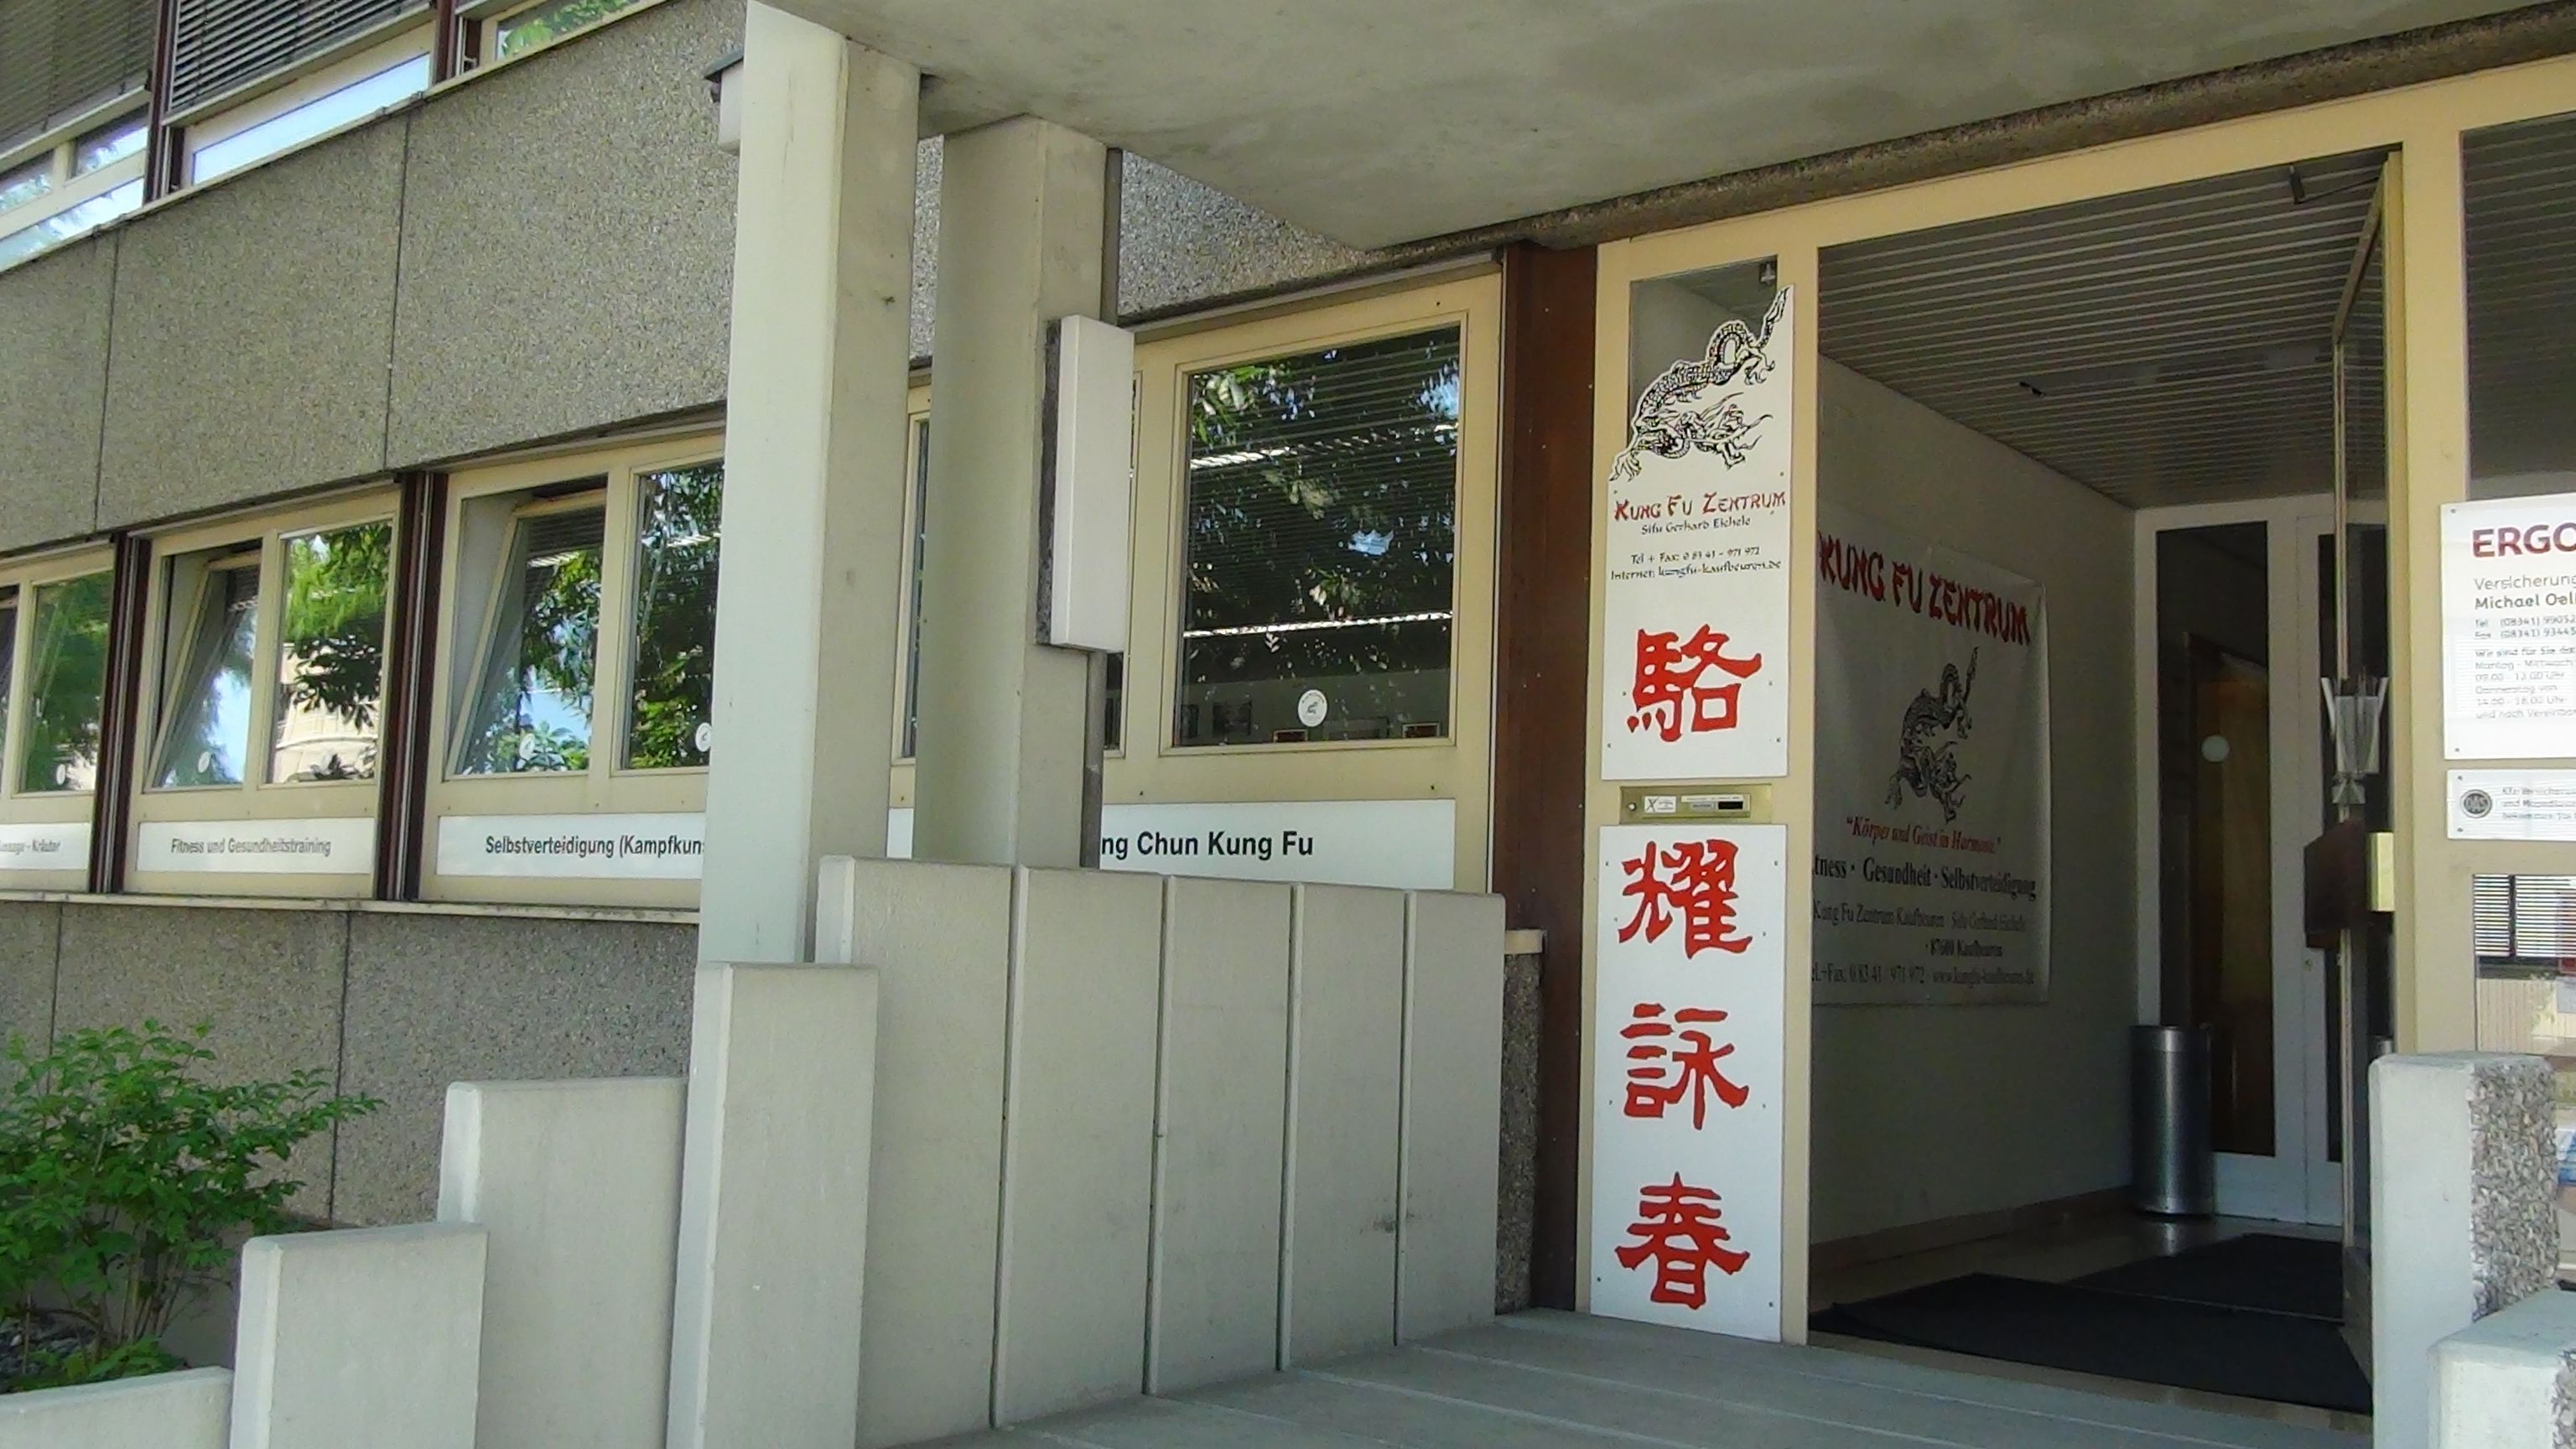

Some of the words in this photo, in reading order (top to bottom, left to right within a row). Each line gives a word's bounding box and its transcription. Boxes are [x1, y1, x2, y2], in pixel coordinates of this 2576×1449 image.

[1641, 522, 1663, 535] Sifu
[2473, 522, 2576, 558] ERGO
[1817, 530, 1885, 601] KUNG
[1892, 561, 1922, 614] FU
[1929, 572, 2030, 647] ZENTRUM
[2475, 594, 2540, 610] Michael
[171, 839, 204, 854] Fitness
[207, 839, 224, 854] und
[228, 838, 331, 857] Gesundheitstraining
[486, 835, 615, 858] Selbstverteidigung
[1137, 831, 1198, 856] Chun
[1208, 830, 1272, 860] Kung
[1282, 831, 1313, 855] Fu
[1812, 854, 1846, 879] tness
[1862, 856, 1932, 887] Gesundheit
[1941, 865, 2037, 901] Selbstverteidigung
